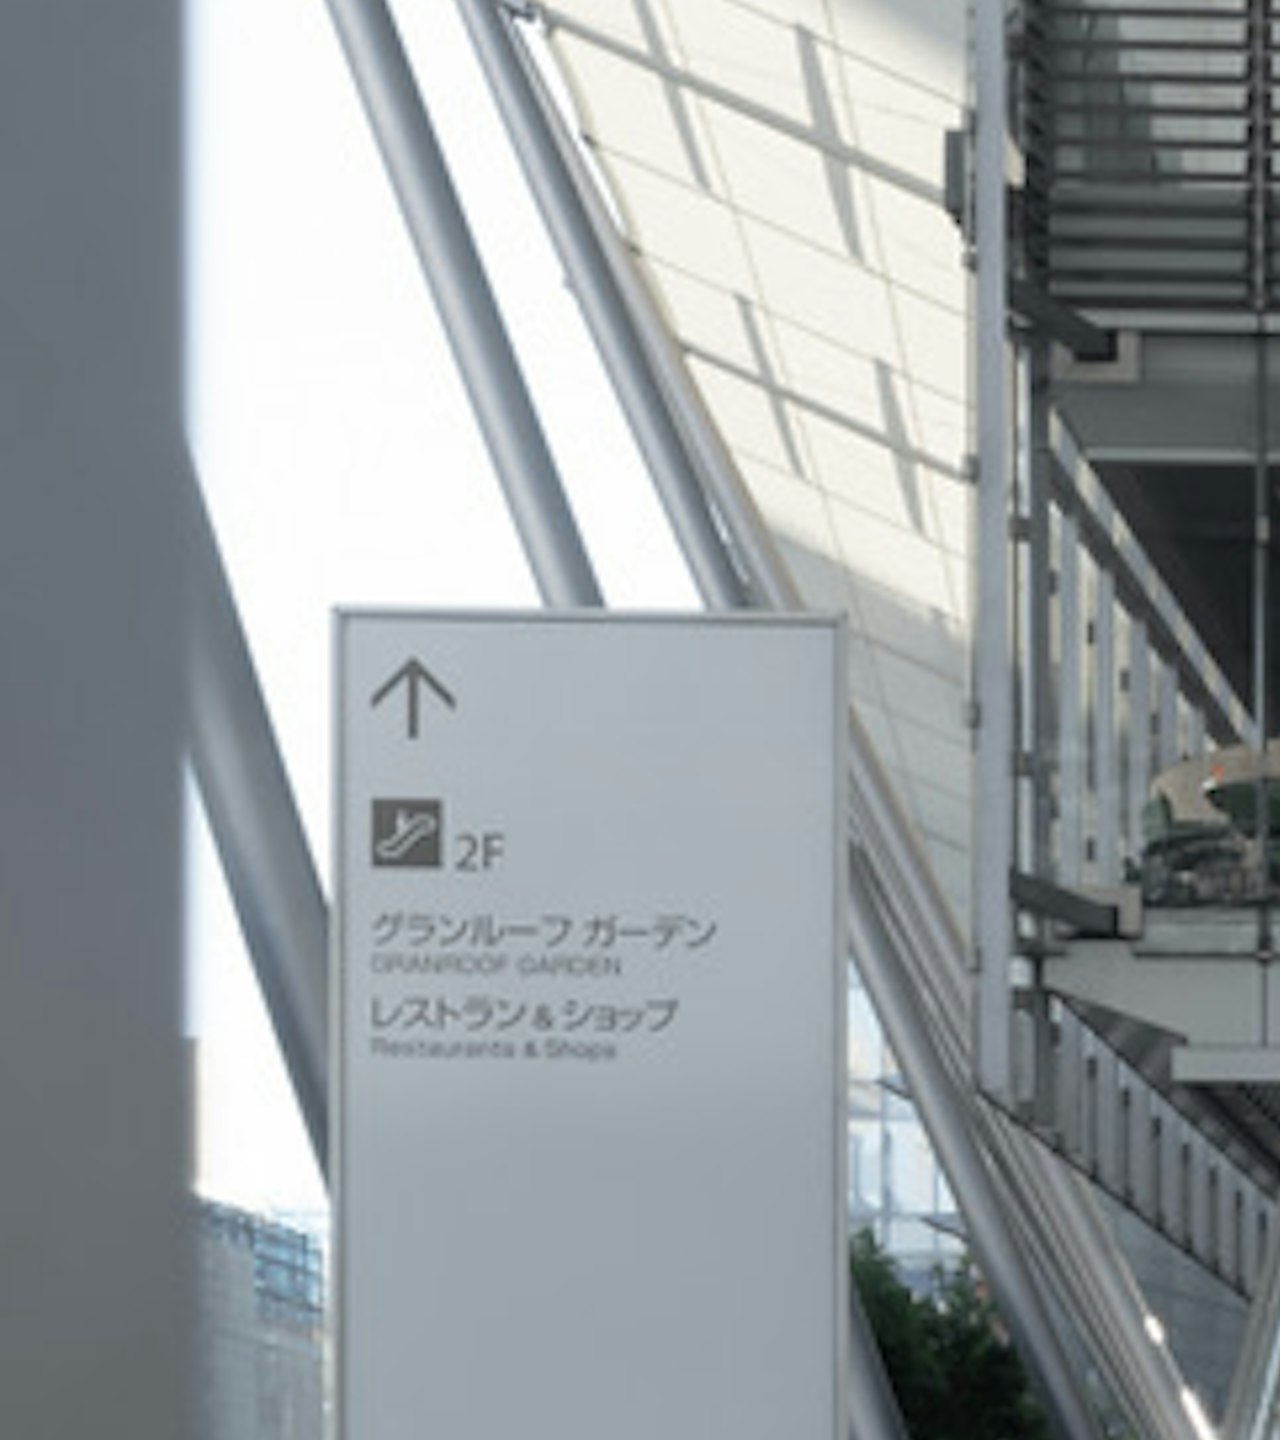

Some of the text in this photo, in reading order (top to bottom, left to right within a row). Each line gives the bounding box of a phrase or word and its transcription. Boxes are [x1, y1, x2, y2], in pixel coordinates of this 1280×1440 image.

[454, 833, 505, 873] 2F
[371, 912, 718, 950] グランルーフ ガーデン
[370, 1038, 515, 1060] Restaurants
[545, 1038, 618, 1063] Shops
